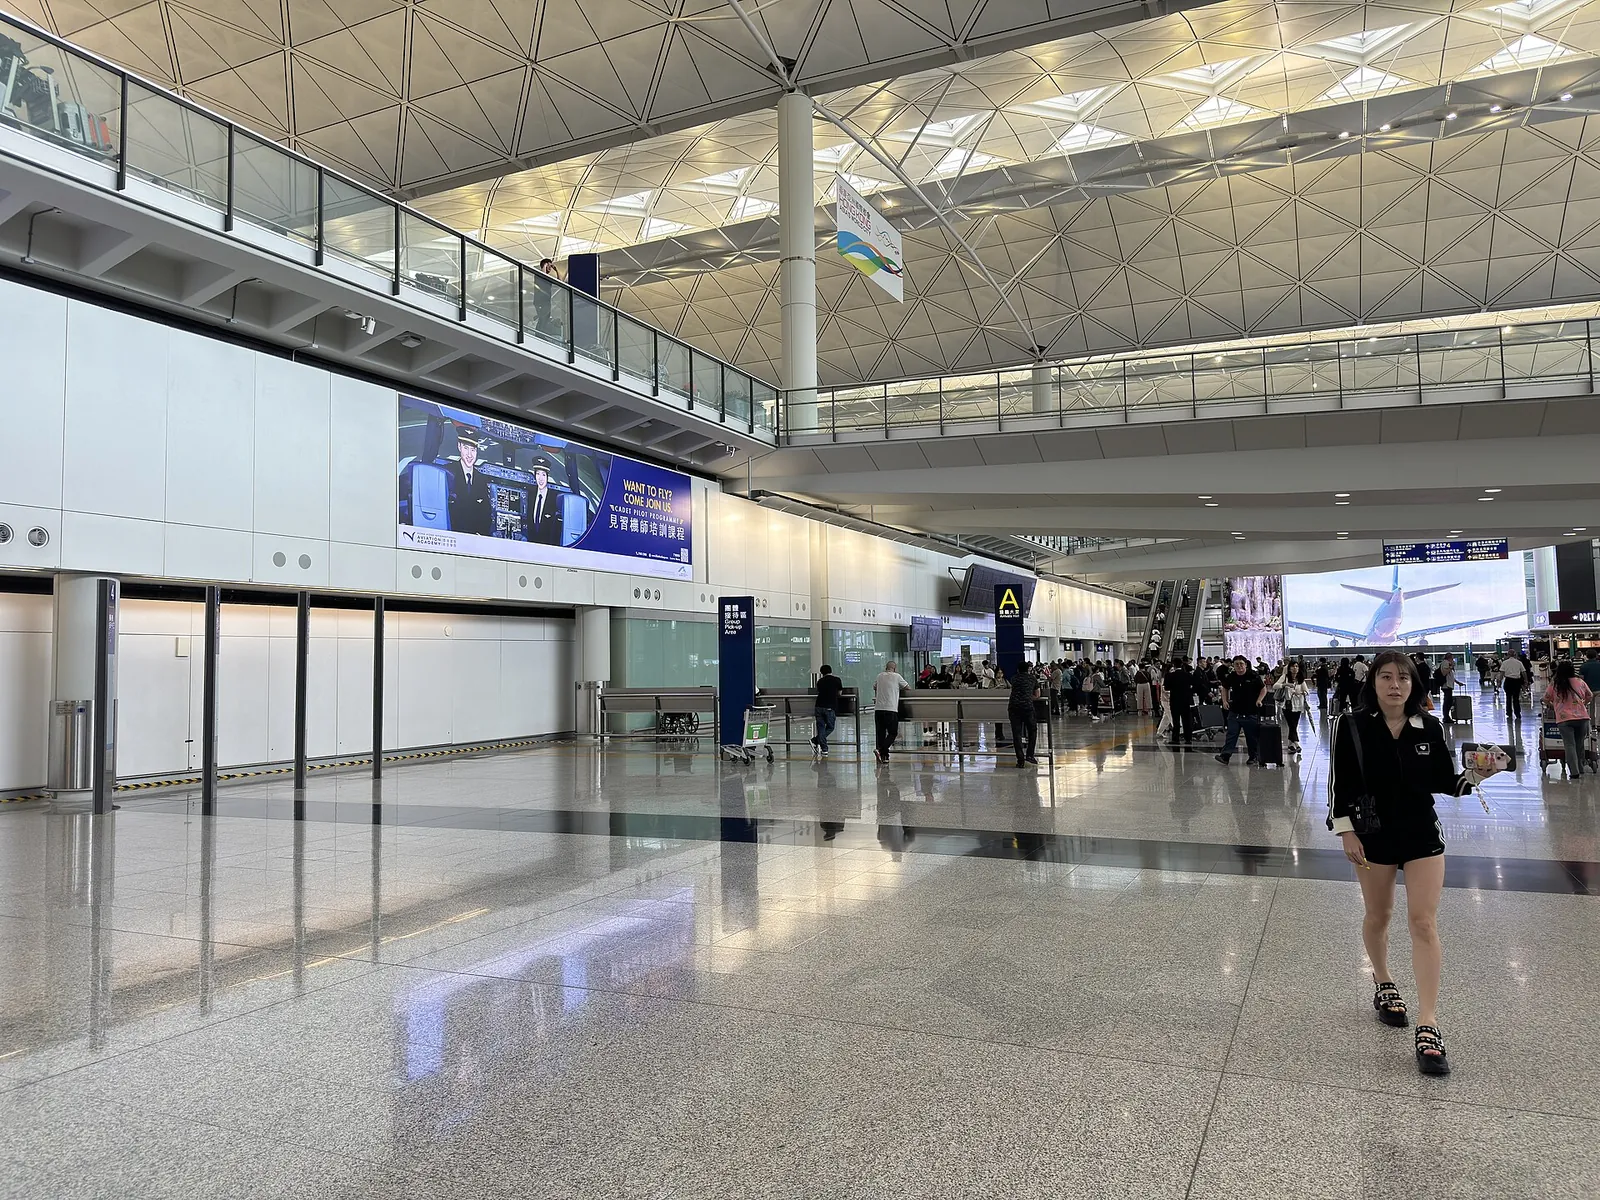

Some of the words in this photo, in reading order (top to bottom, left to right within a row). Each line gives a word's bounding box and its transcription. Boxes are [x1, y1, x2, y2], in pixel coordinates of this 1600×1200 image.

[839, 195, 855, 217] HONG
[855, 211, 872, 231] KONG
[623, 479, 646, 495] WANT
[647, 484, 657, 497] TO
[658, 487, 673, 501] FLY?
[623, 493, 644, 507] COME
[645, 497, 661, 511] JOIN
[662, 503, 673, 513] US.
[614, 506, 632, 515] CADET
[633, 509, 648, 518] PILOT
[649, 512, 680, 524] PROGRAMME
[609, 514, 685, 541] 見習機師培訓課程
[999, 588, 1019, 609] A
[1579, 613, 1594, 622] PRET
